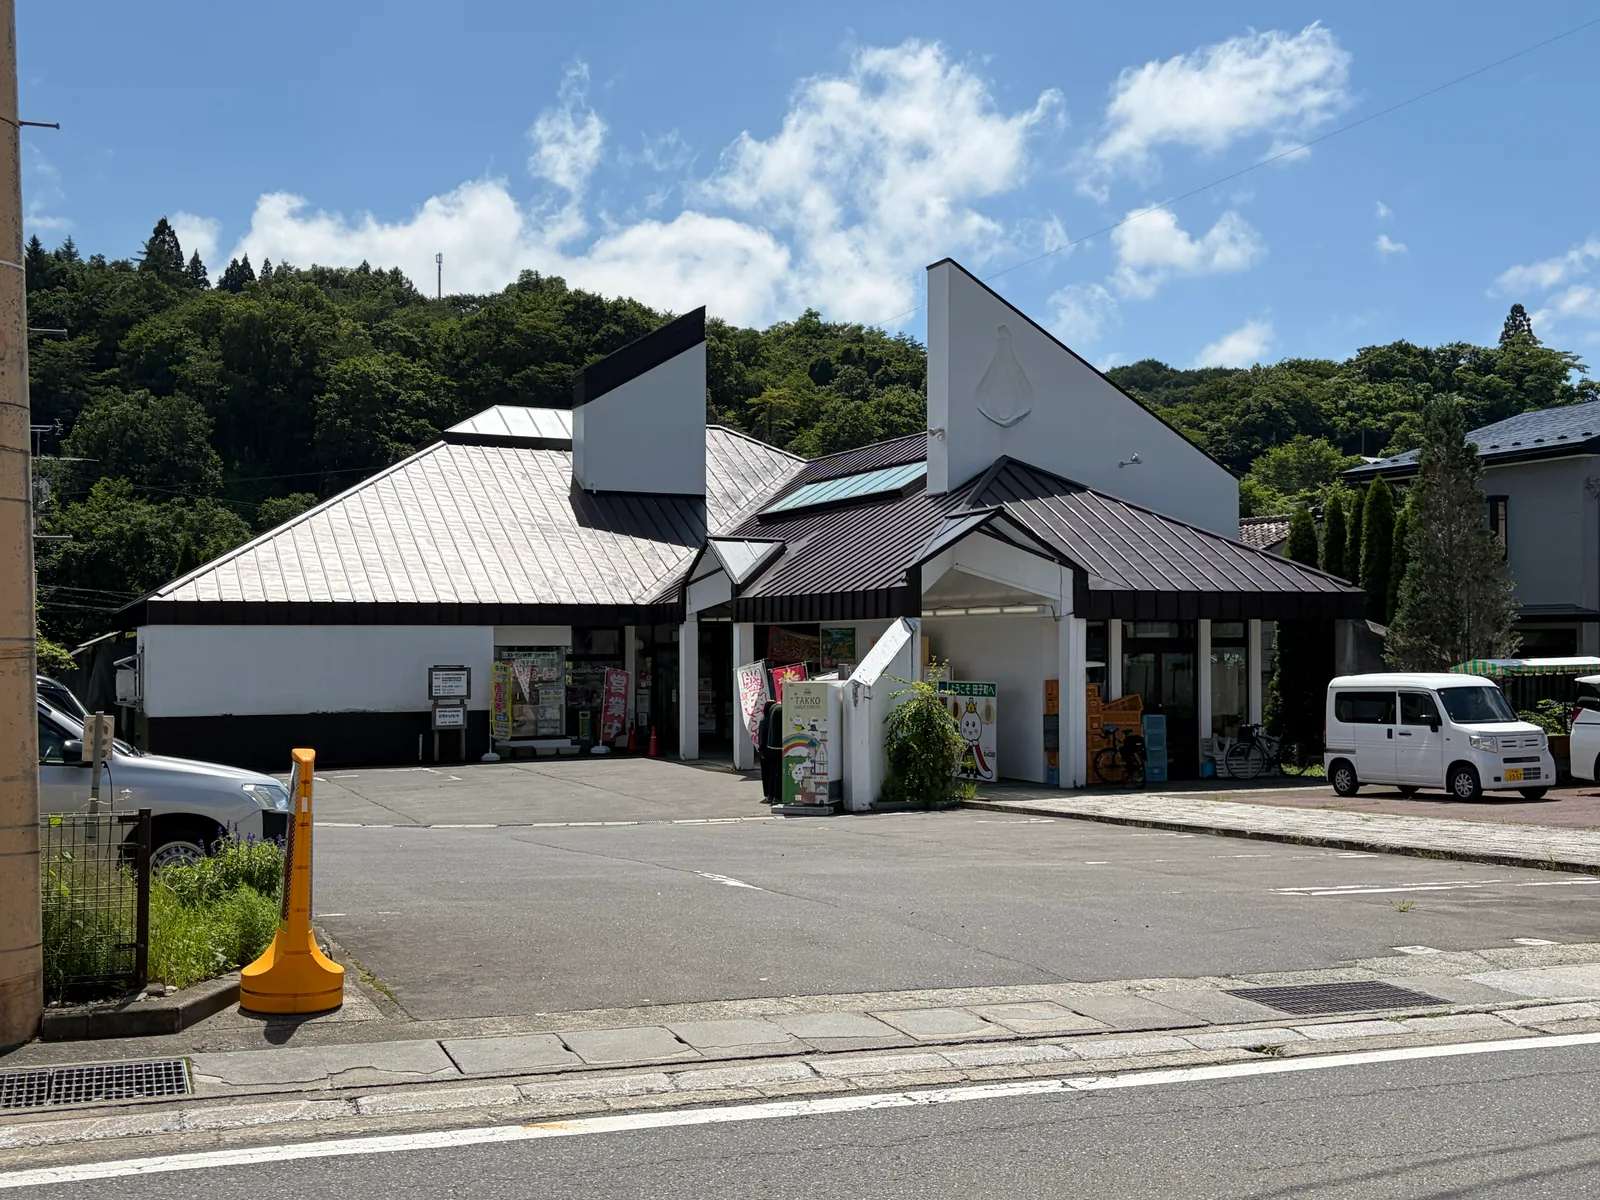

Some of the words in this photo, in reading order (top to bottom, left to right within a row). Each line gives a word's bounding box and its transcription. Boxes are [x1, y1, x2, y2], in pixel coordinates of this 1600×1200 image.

[951, 684, 971, 695] ようこそ
[604, 673, 627, 739] 営業中
[795, 696, 821, 705] TAKKO
